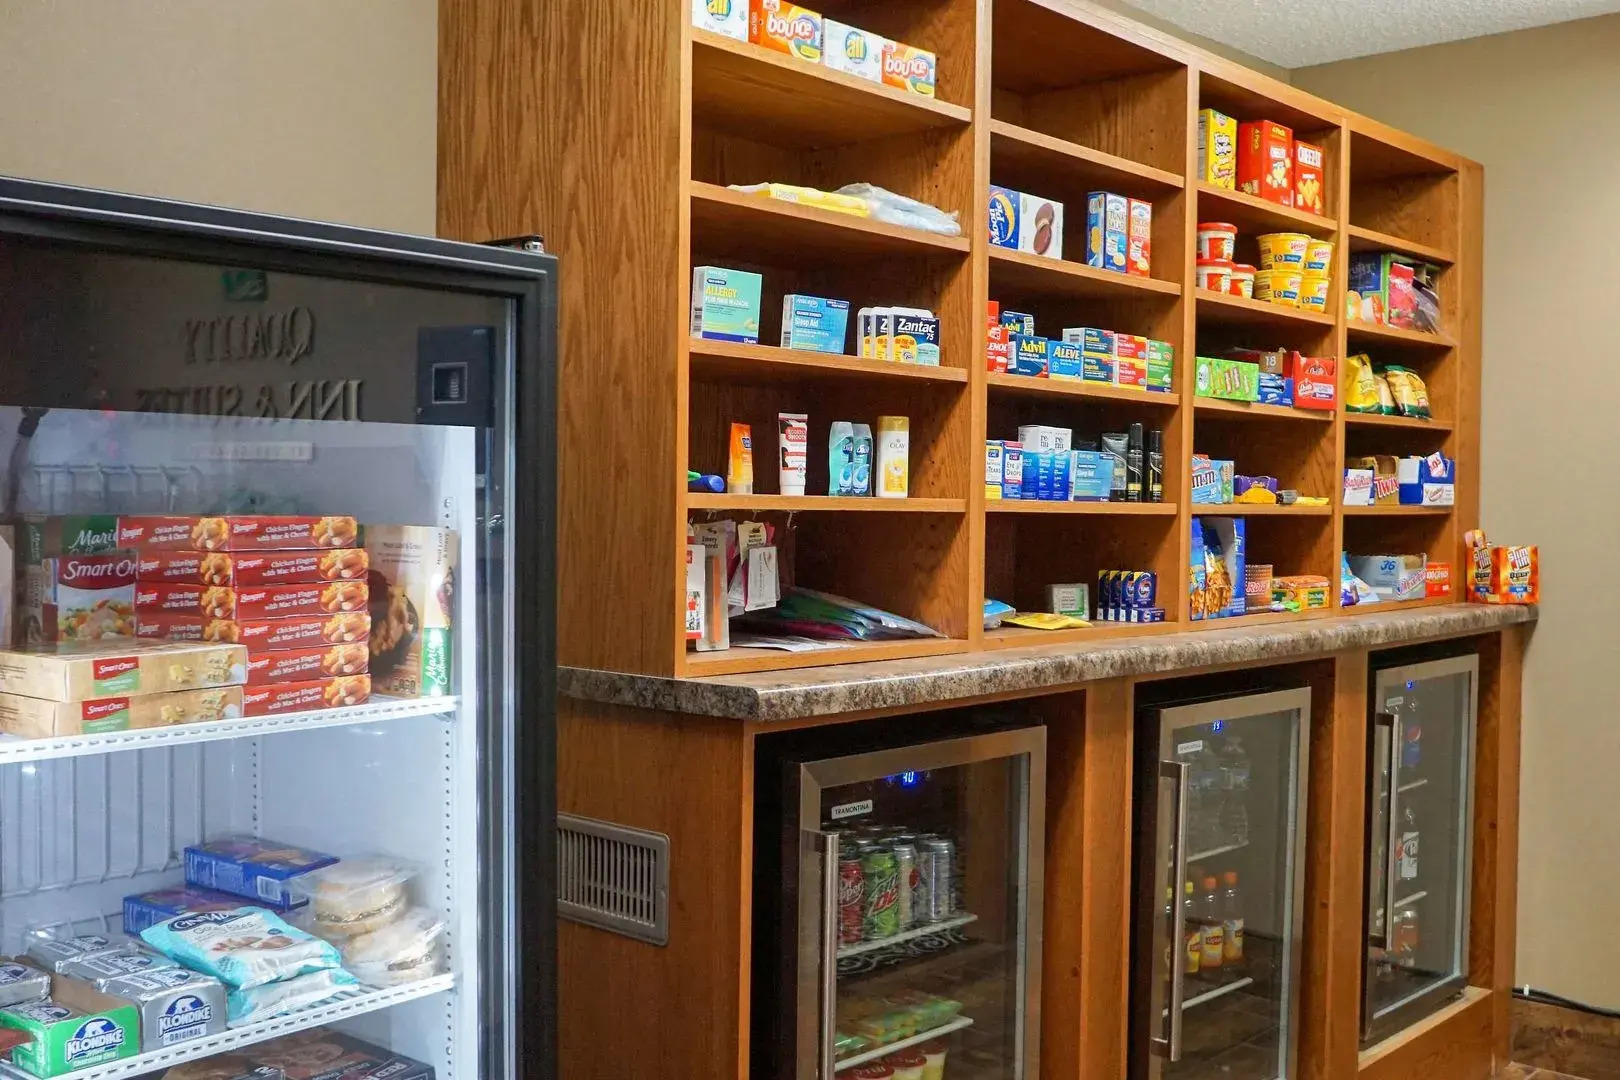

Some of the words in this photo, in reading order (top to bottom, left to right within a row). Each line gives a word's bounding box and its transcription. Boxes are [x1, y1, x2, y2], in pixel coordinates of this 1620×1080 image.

[847, 36, 864, 58] all
[886, 51, 927, 77] bounce
[897, 318, 936, 333] Zantac
[1020, 339, 1046, 354] Advil
[1053, 345, 1081, 360] ALEVE
[266, 525, 288, 533] Chicken
[64, 558, 113, 580] Smart
[116, 559, 136, 577] On
[271, 559, 296, 568] Chicken
[1381, 560, 1396, 570] 36
[273, 593, 297, 601] Chicken
[276, 626, 300, 634] Chicken
[98, 663, 118, 674] Smart
[276, 692, 300, 700] Chicken
[87, 704, 108, 715] Smart
[835, 803, 869, 815] TRAMONTINA
[159, 1004, 213, 1038] KLONDIKE
[169, 1028, 202, 1042] ORIGINAL
[66, 1027, 124, 1062] KLONDIKE
